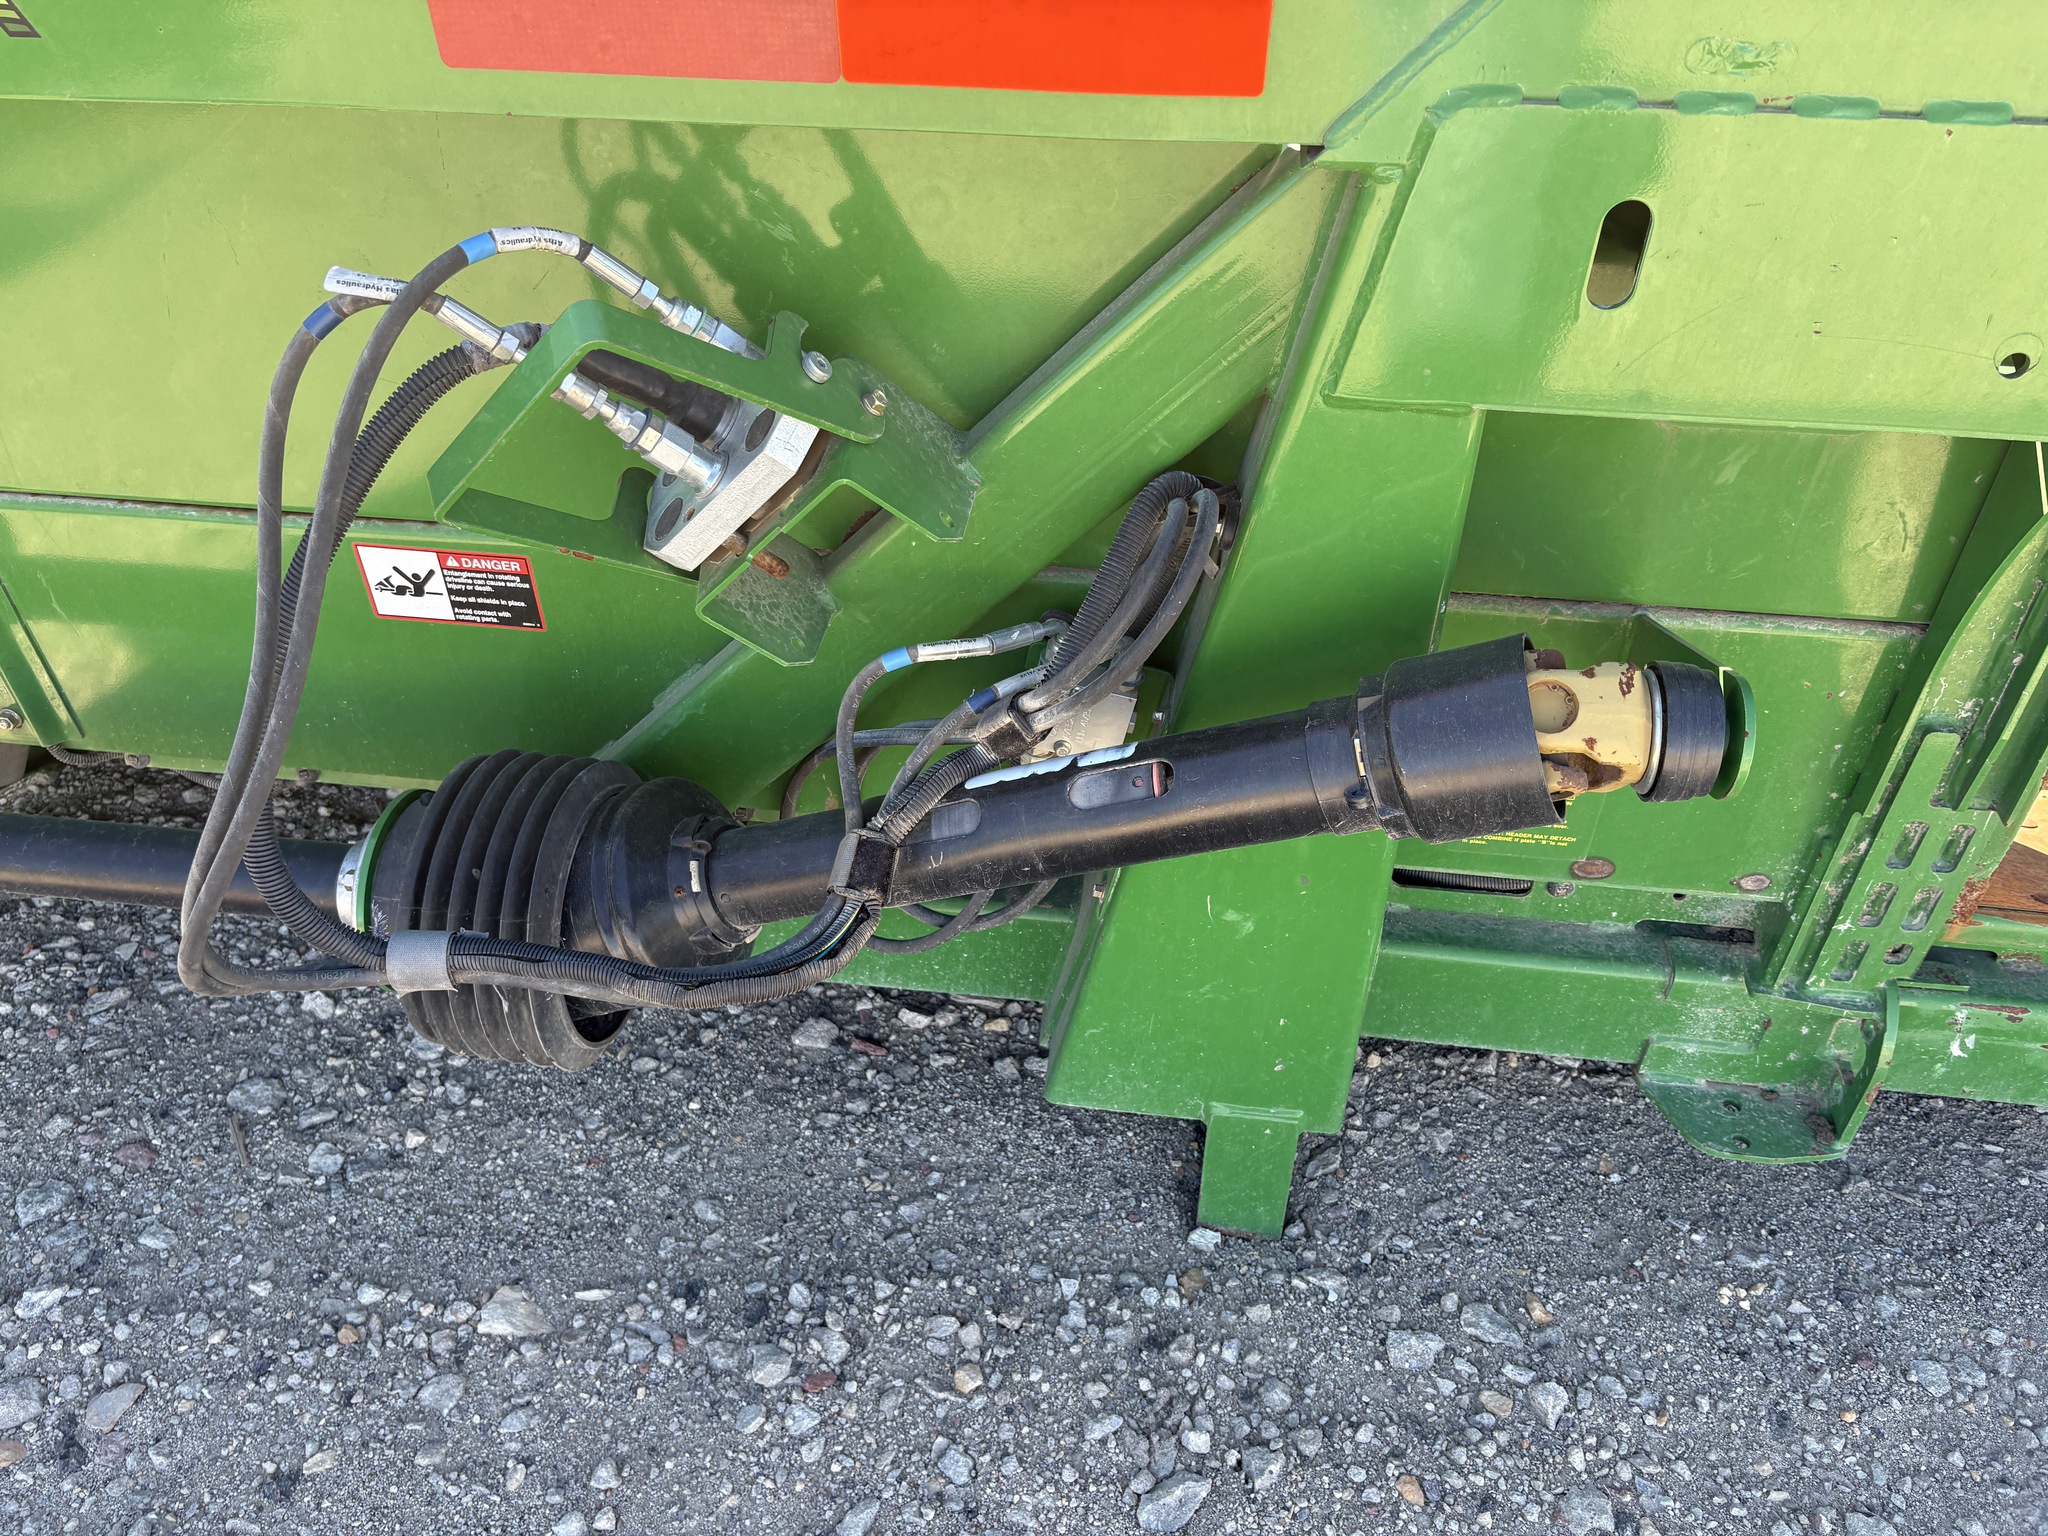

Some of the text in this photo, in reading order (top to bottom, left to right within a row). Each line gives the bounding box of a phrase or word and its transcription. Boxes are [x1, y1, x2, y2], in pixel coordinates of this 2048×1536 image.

[336, 278, 383, 293] Hydraulics
[461, 558, 521, 572] DANGER
[443, 570, 487, 579] Entanglement
[935, 718, 958, 740] 3000
